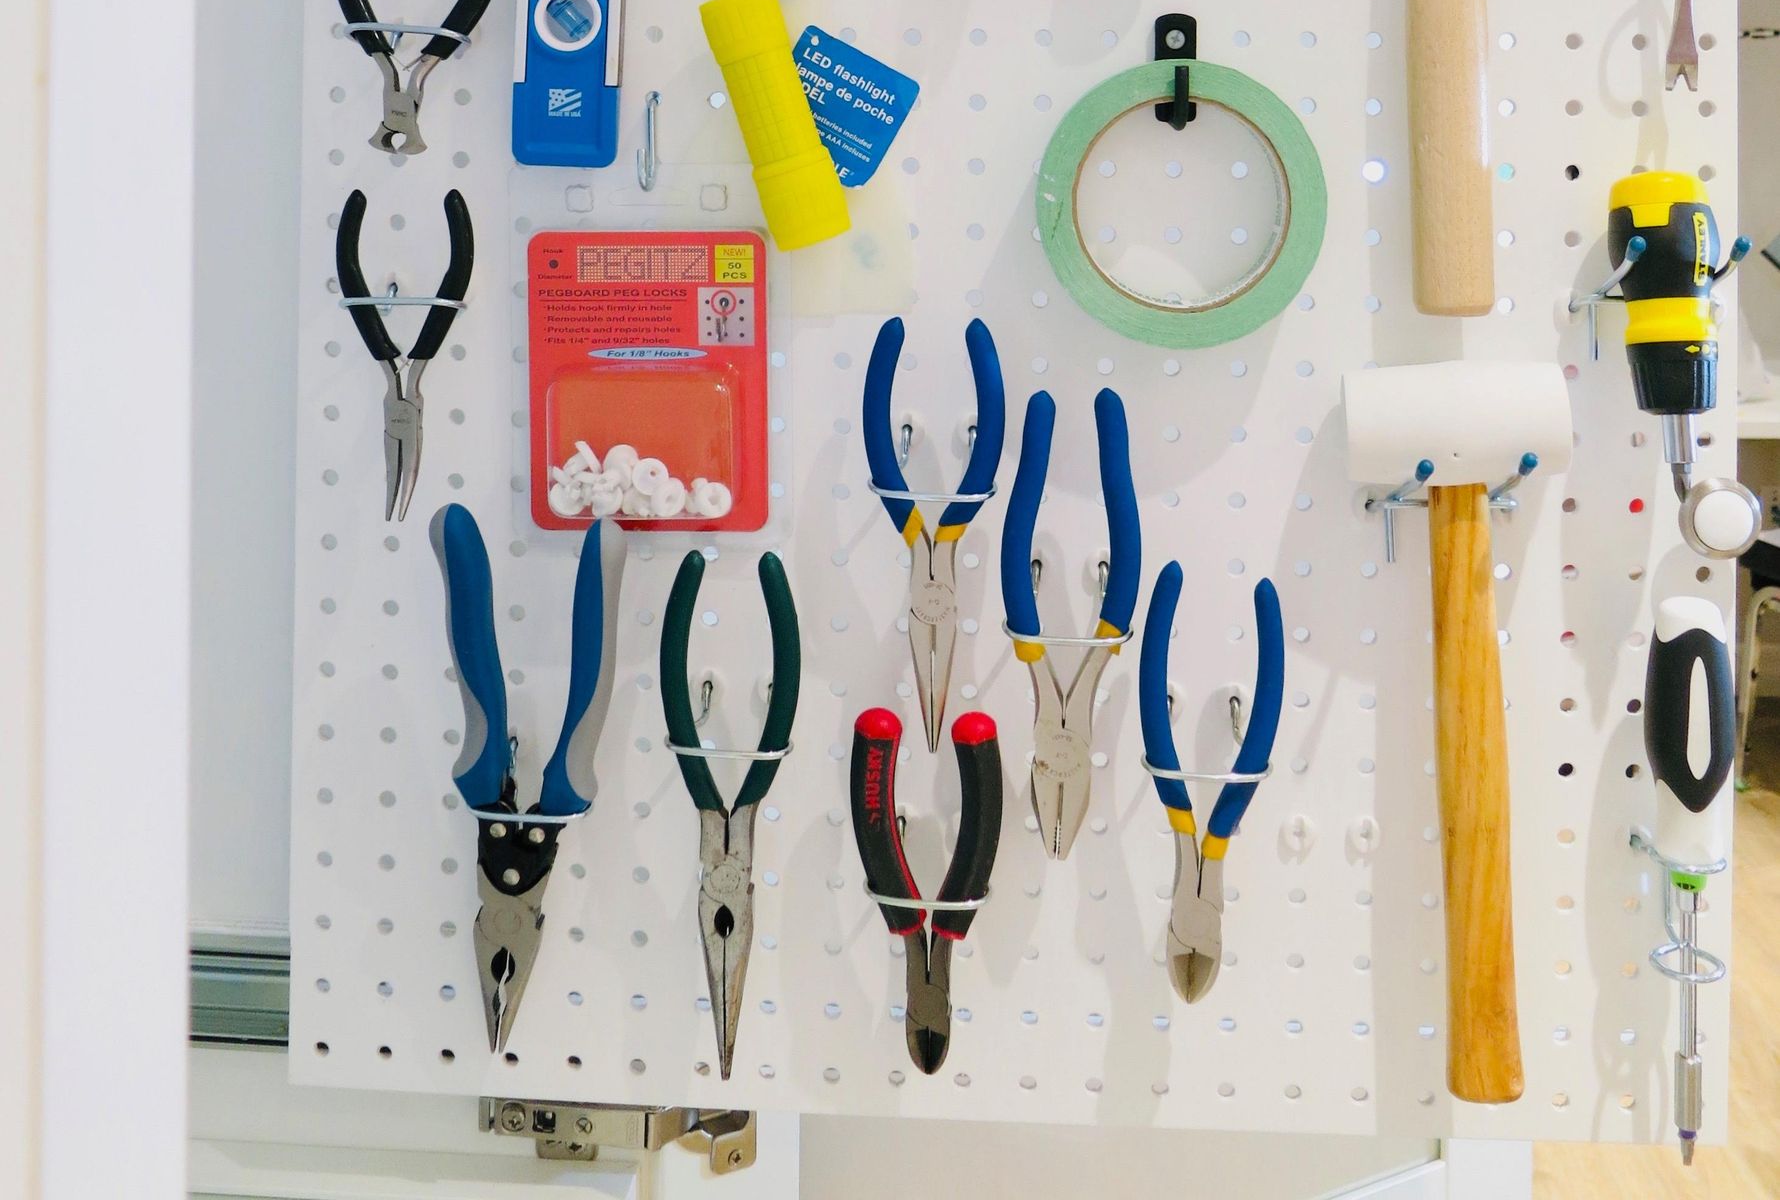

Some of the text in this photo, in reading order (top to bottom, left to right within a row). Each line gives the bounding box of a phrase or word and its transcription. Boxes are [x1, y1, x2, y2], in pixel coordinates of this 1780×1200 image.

[803, 47, 896, 106] LED flashlight
[796, 62, 894, 125] lampe de poche
[826, 134, 871, 163] AAA incluses
[842, 129, 873, 150] included
[581, 248, 706, 280] PEGITZ
[723, 248, 746, 257] NEW!
[727, 262, 742, 270] 50
[538, 289, 687, 297] PEGBOARD PEG LOCKS
[864, 745, 884, 810] HUSKY
